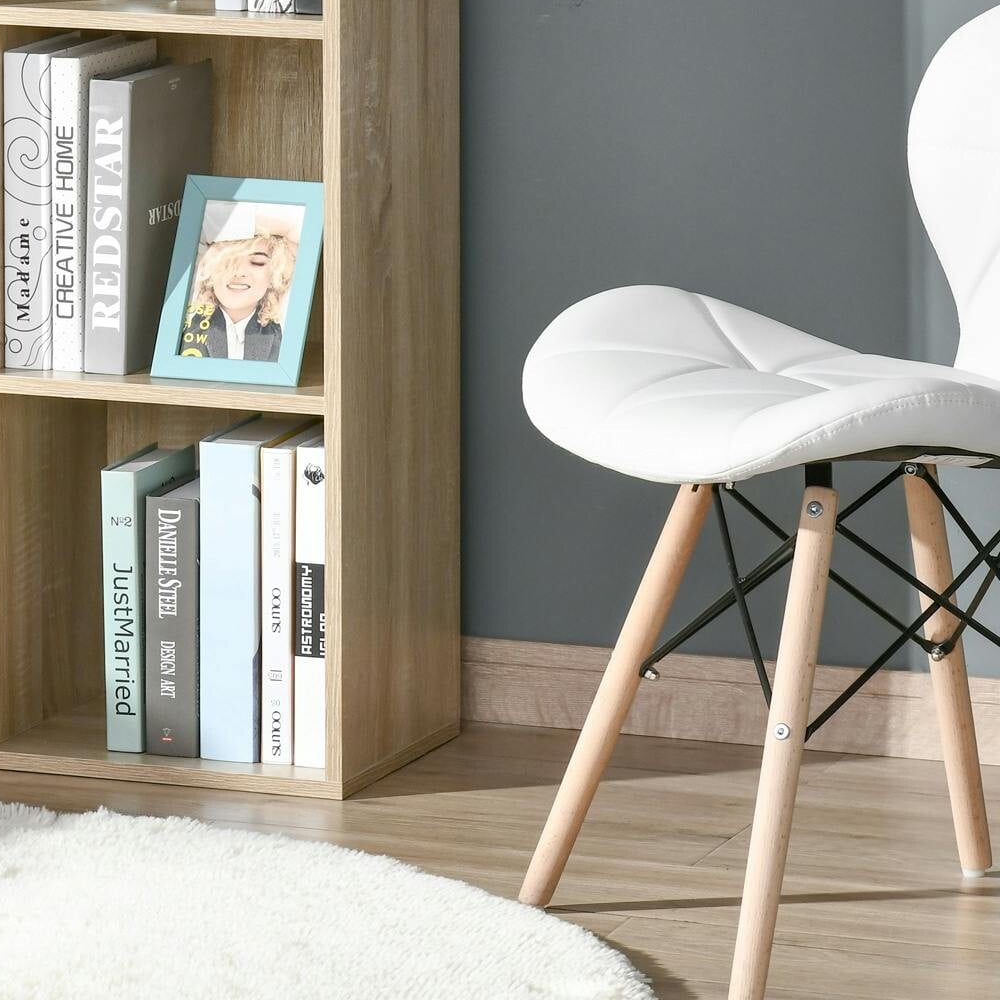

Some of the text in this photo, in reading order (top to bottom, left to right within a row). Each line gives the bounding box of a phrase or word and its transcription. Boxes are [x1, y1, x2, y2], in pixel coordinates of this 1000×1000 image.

[56, 125, 74, 319] CREATIVE HOME
[92, 116, 123, 332] REDSTAR
[149, 200, 180, 225] DSTAR
[17, 217, 30, 321] Madame
[158, 508, 181, 575] DANIELLE
[158, 577, 182, 619] STEEL
[301, 565, 313, 655] ASTRONOMY
[160, 641, 176, 699] DESIGN ART
